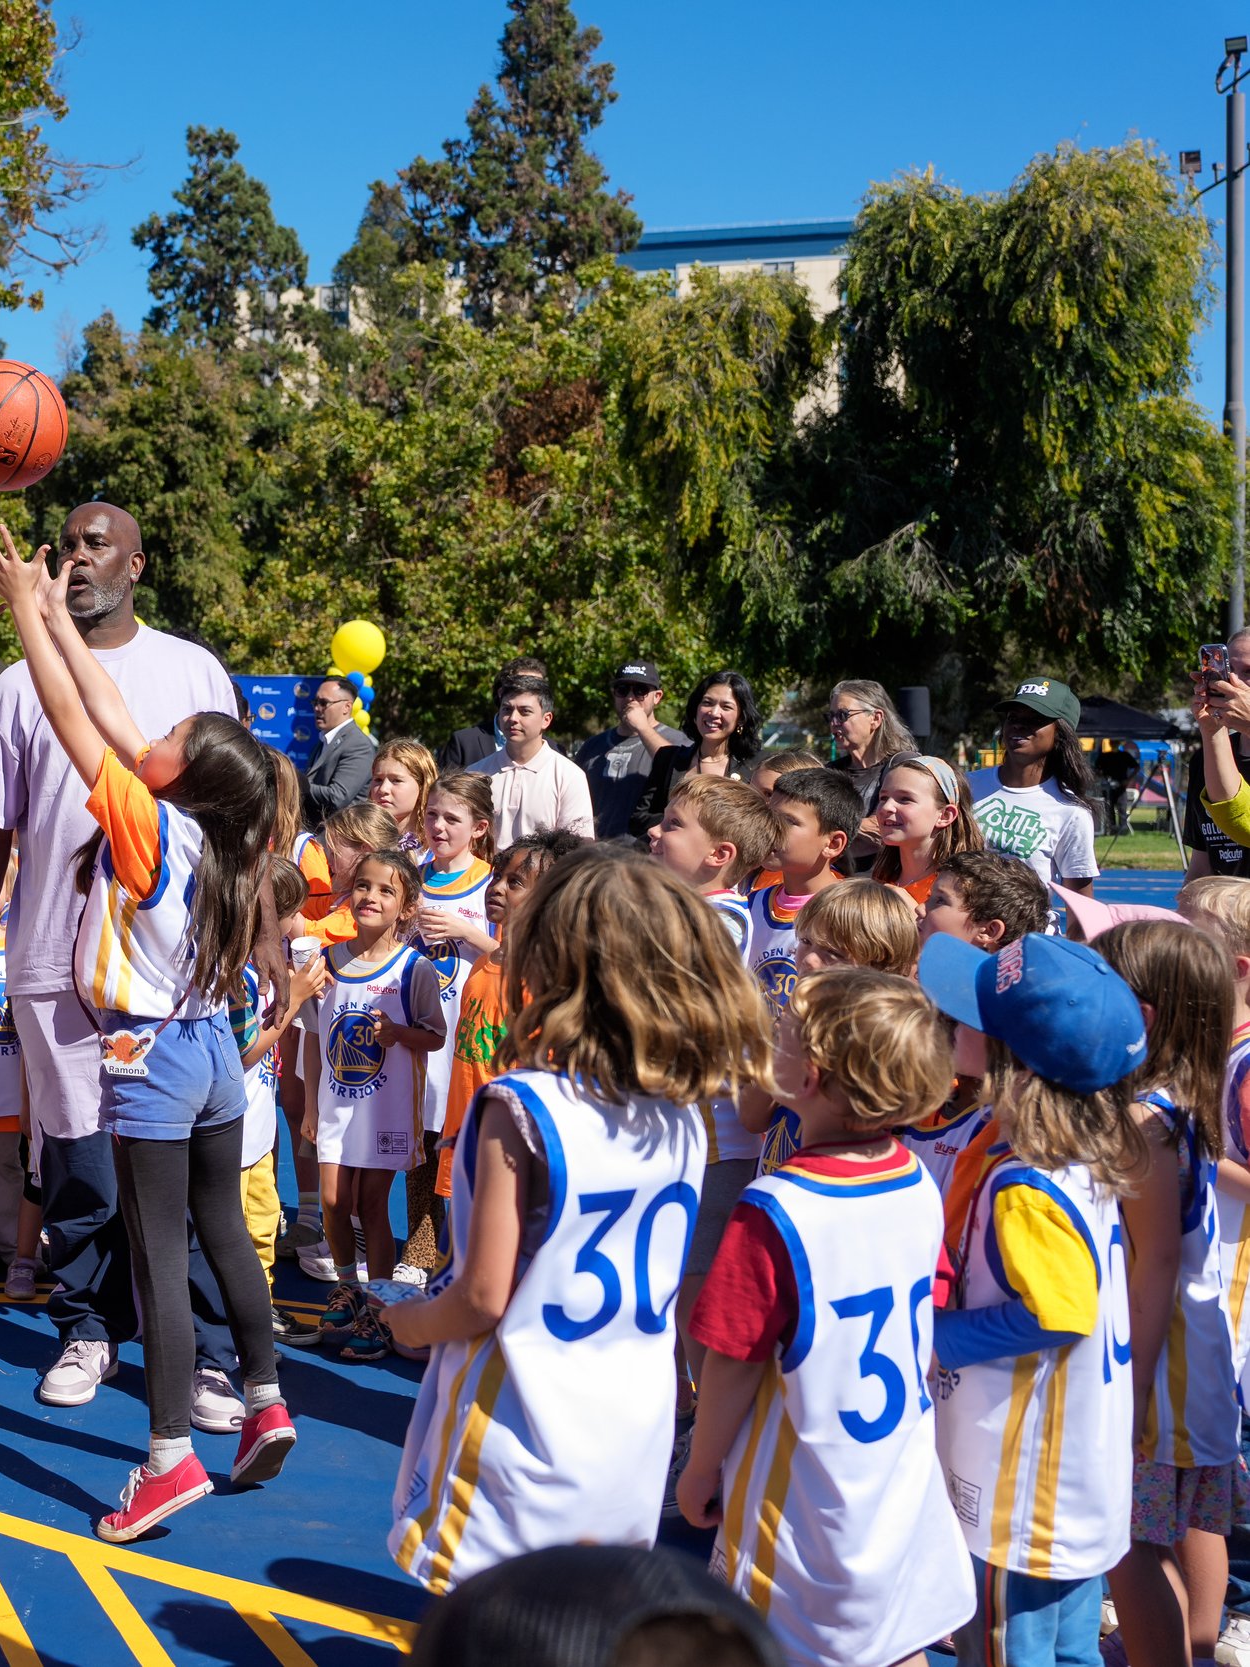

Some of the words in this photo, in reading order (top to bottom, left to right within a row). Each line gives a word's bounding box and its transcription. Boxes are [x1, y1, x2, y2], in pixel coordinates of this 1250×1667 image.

[457, 906, 484, 920] Rakuten
[366, 984, 398, 996] Rakuten
[771, 973, 799, 997] 30
[352, 1025, 375, 1047] 30
[108, 1065, 146, 1076] Ramona
[543, 1182, 700, 1342] 30
[829, 1275, 934, 1445] 30
